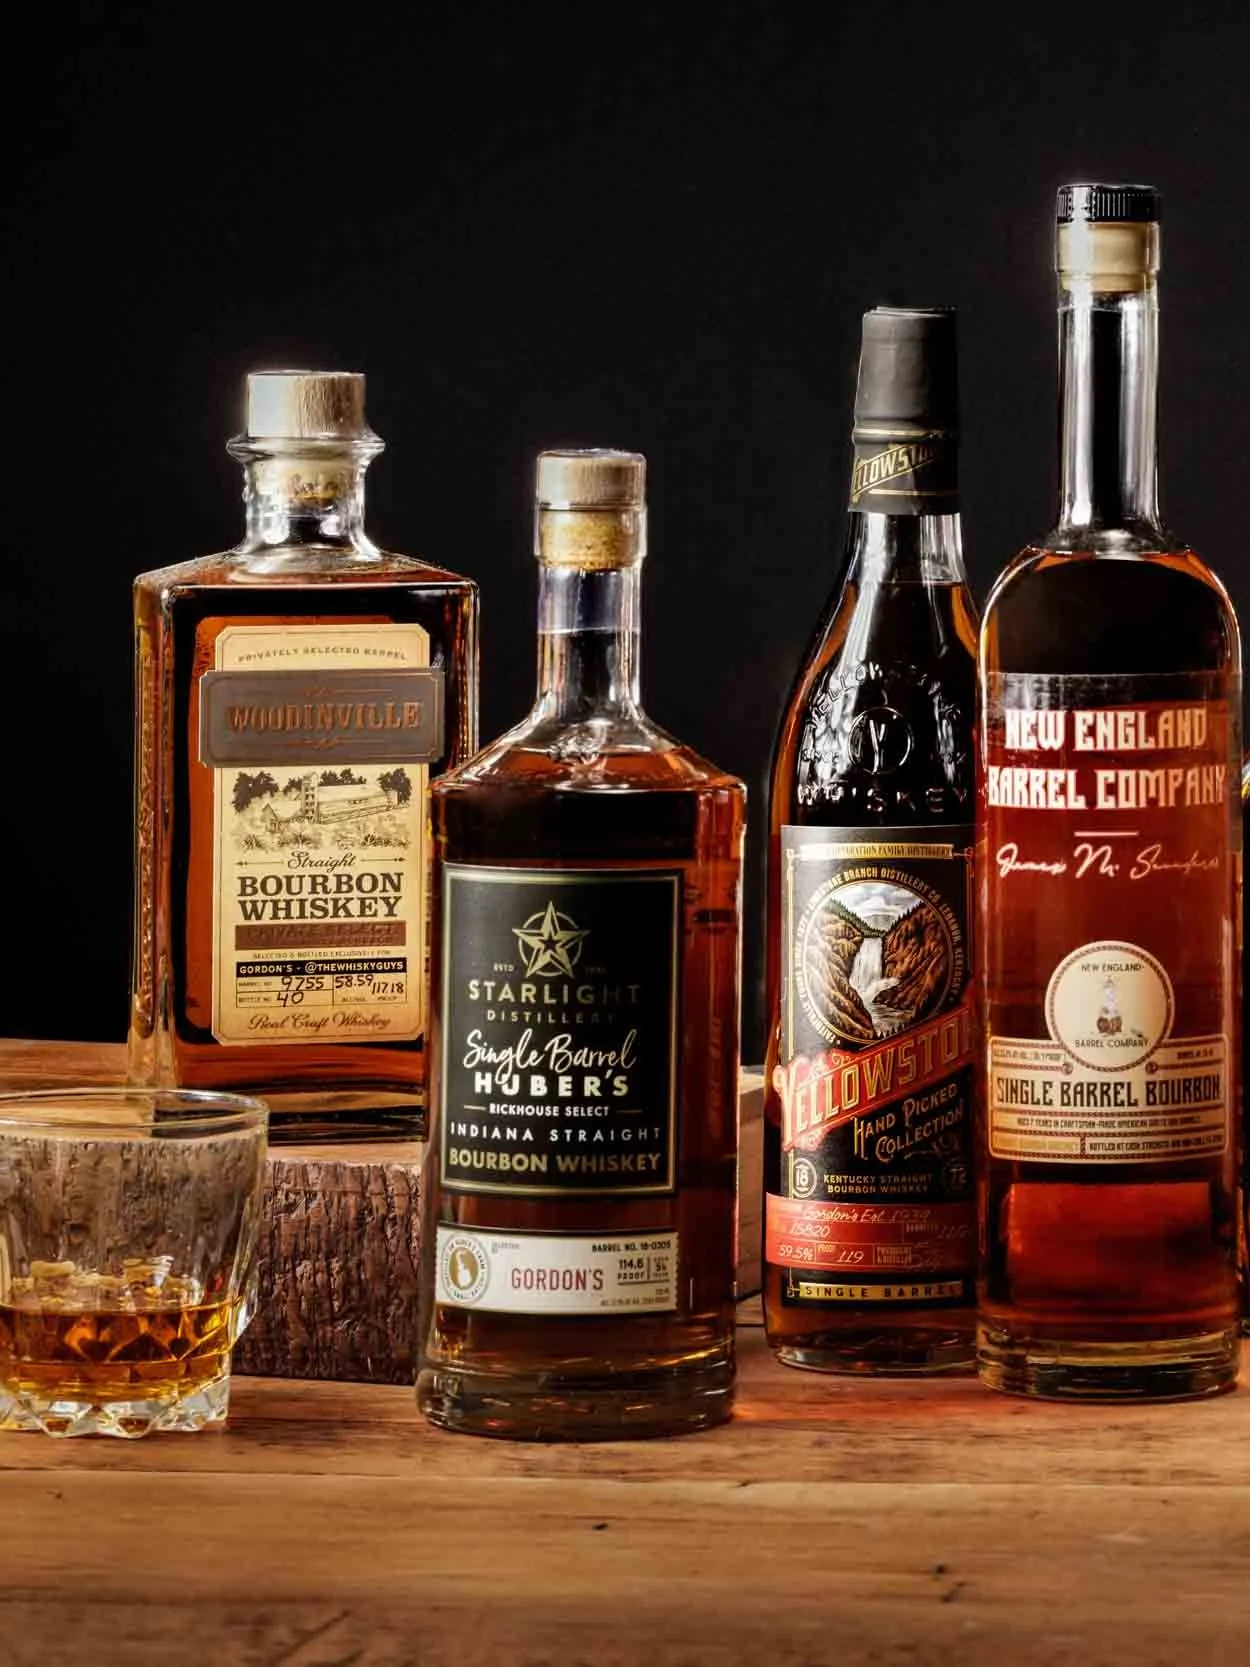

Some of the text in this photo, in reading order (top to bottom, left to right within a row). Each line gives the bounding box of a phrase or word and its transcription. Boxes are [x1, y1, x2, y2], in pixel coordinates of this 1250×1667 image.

[238, 646, 407, 664] PRIVATELY SELECTED BARREL
[227, 699, 422, 732] WOODINVILLE
[1005, 707, 1208, 751] NEW ENGLAND
[988, 764, 1226, 811] BARREL COMPANY
[287, 850, 358, 874] Straight
[237, 872, 405, 898] BOURBON
[843, 866, 930, 896] BRANCH DISTILLERY
[238, 895, 403, 921] WHISKEY
[239, 961, 404, 975] GORDON'S @THEWHISKYGUYS
[1081, 963, 1143, 973] NEW ENGLAND
[281, 975, 326, 992] 9755
[334, 974, 375, 990] 58.59
[468, 979, 641, 1005] STARLIGHT
[276, 991, 305, 1008] 40
[248, 1011, 391, 1033] Real Craft Whiskey
[486, 1008, 617, 1025] DISTILLERY
[1074, 1038, 1149, 1049] BARREL COMPANY
[463, 1027, 638, 1086] Single Barrel
[474, 1068, 630, 1098] HUBER'S
[771, 1008, 974, 1148] YELLOWSTO
[996, 1074, 1221, 1108] SINGLE BARREL BOURBON
[488, 1102, 610, 1118] RICKHOUSE SELECT
[851, 1082, 958, 1161] HAND PICKED
[450, 1121, 661, 1143] INDIANA STRAIGHT
[875, 1097, 964, 1163] COLLECTION
[449, 1147, 662, 1174] BOURBON WHISKEY
[823, 1173, 933, 1184] KENTUCKY STRAIGHT
[827, 1185, 929, 1194] BOURBON WHISKEY
[837, 1250, 866, 1264] 119
[511, 1267, 605, 1293] GORDON'S
[805, 1284, 957, 1298] SINGLE BARREL
